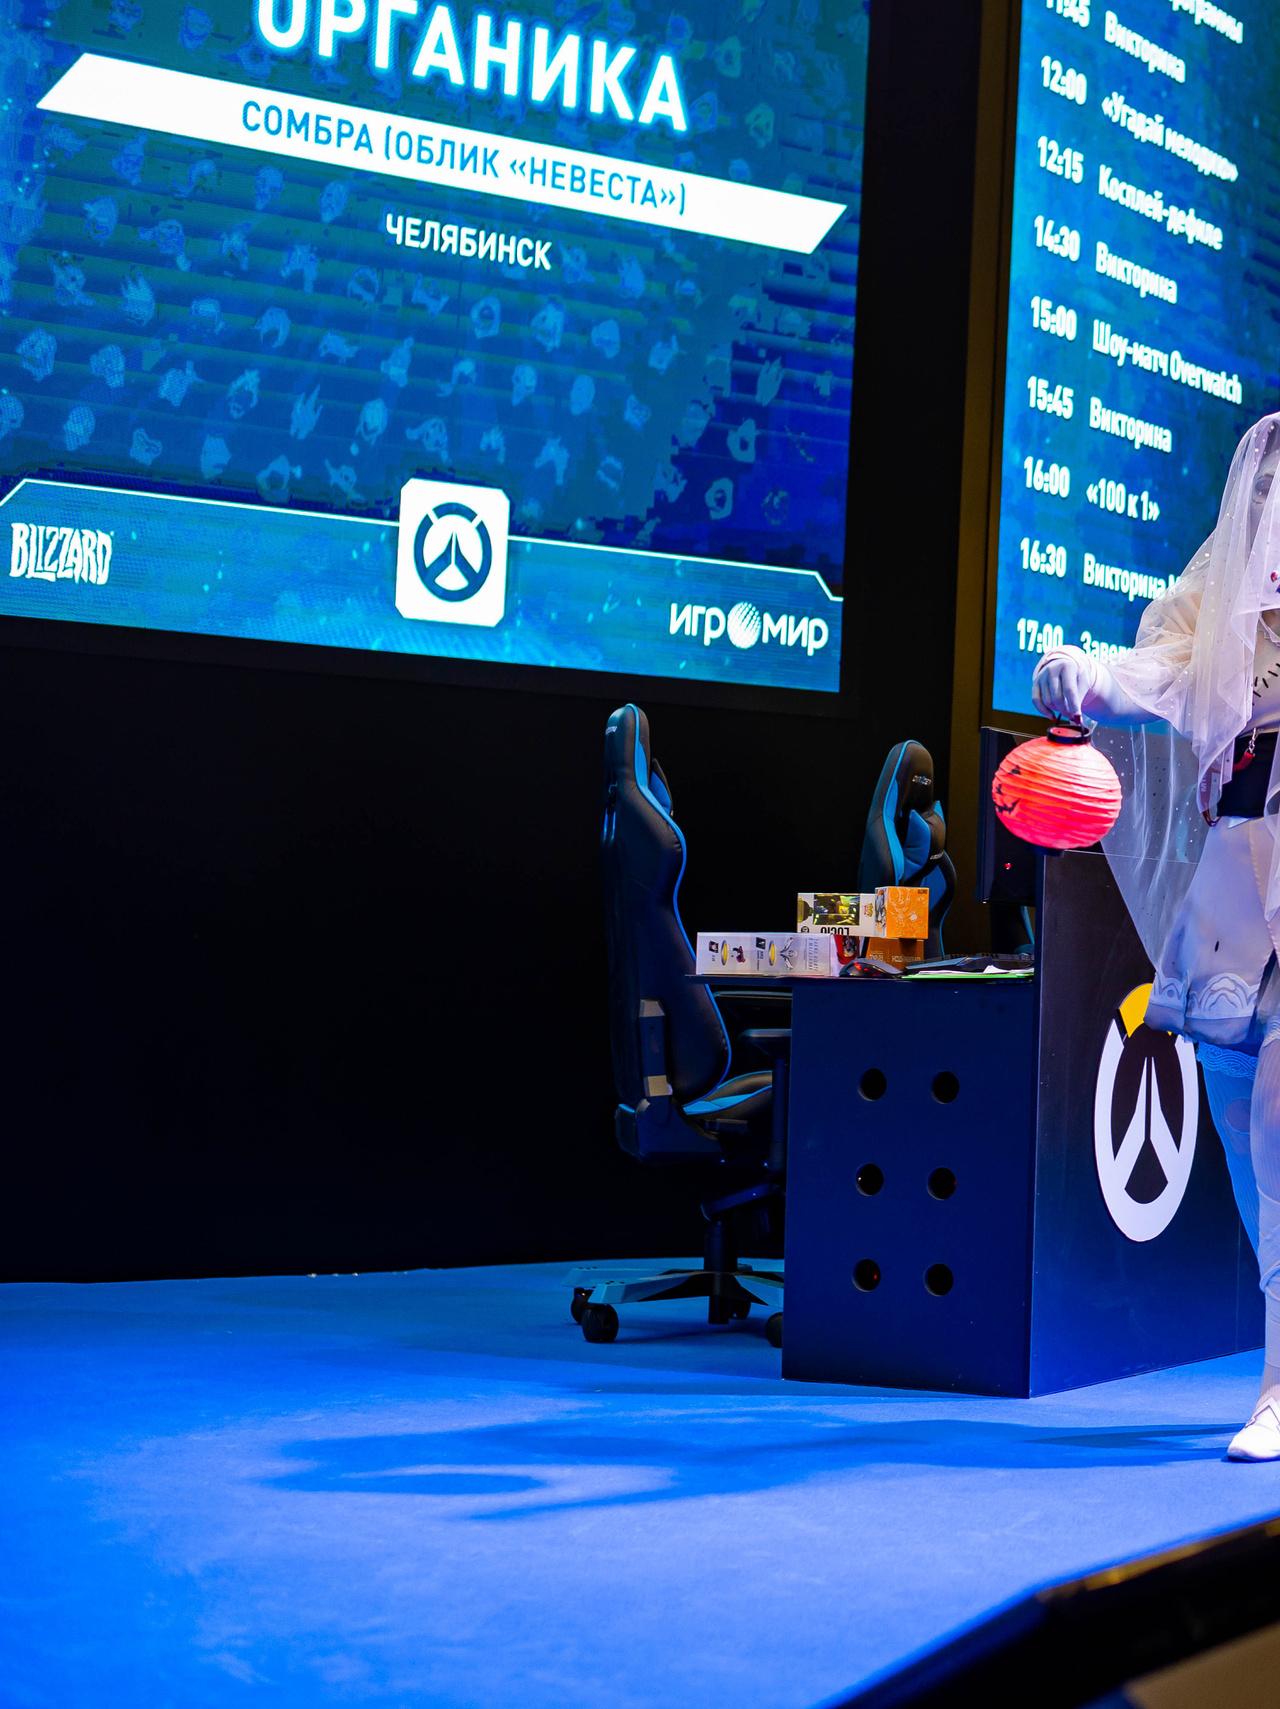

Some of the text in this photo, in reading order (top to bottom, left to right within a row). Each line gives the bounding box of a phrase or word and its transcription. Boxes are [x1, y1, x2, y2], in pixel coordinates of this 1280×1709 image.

[257, 0, 687, 131] ОРГАНИКА
[1041, 56, 1087, 105] 12:00
[1104, 11, 1185, 83] Викторина
[243, 101, 374, 155] СОМБРА
[385, 125, 500, 178] (ОБЛИК
[1037, 136, 1224, 250] 12:15 Косплей-дефиле
[386, 213, 552, 271] ЧЕЛЯБИНСК
[1034, 215, 1178, 304] 14:30 Викторина
[1031, 296, 1242, 404] 15:00 Шоу-матч Overwatch
[1027, 376, 1172, 453] 15:45 Викторина
[1023, 456, 1070, 498] 16:00
[1086, 478, 1126, 514] «100
[1140, 491, 1160, 521] 1»
[9, 522, 114, 585] BLIZZARD
[1020, 538, 1067, 578] 16:30
[1083, 552, 1167, 602] Викторина
[1017, 618, 1064, 655] 17:00
